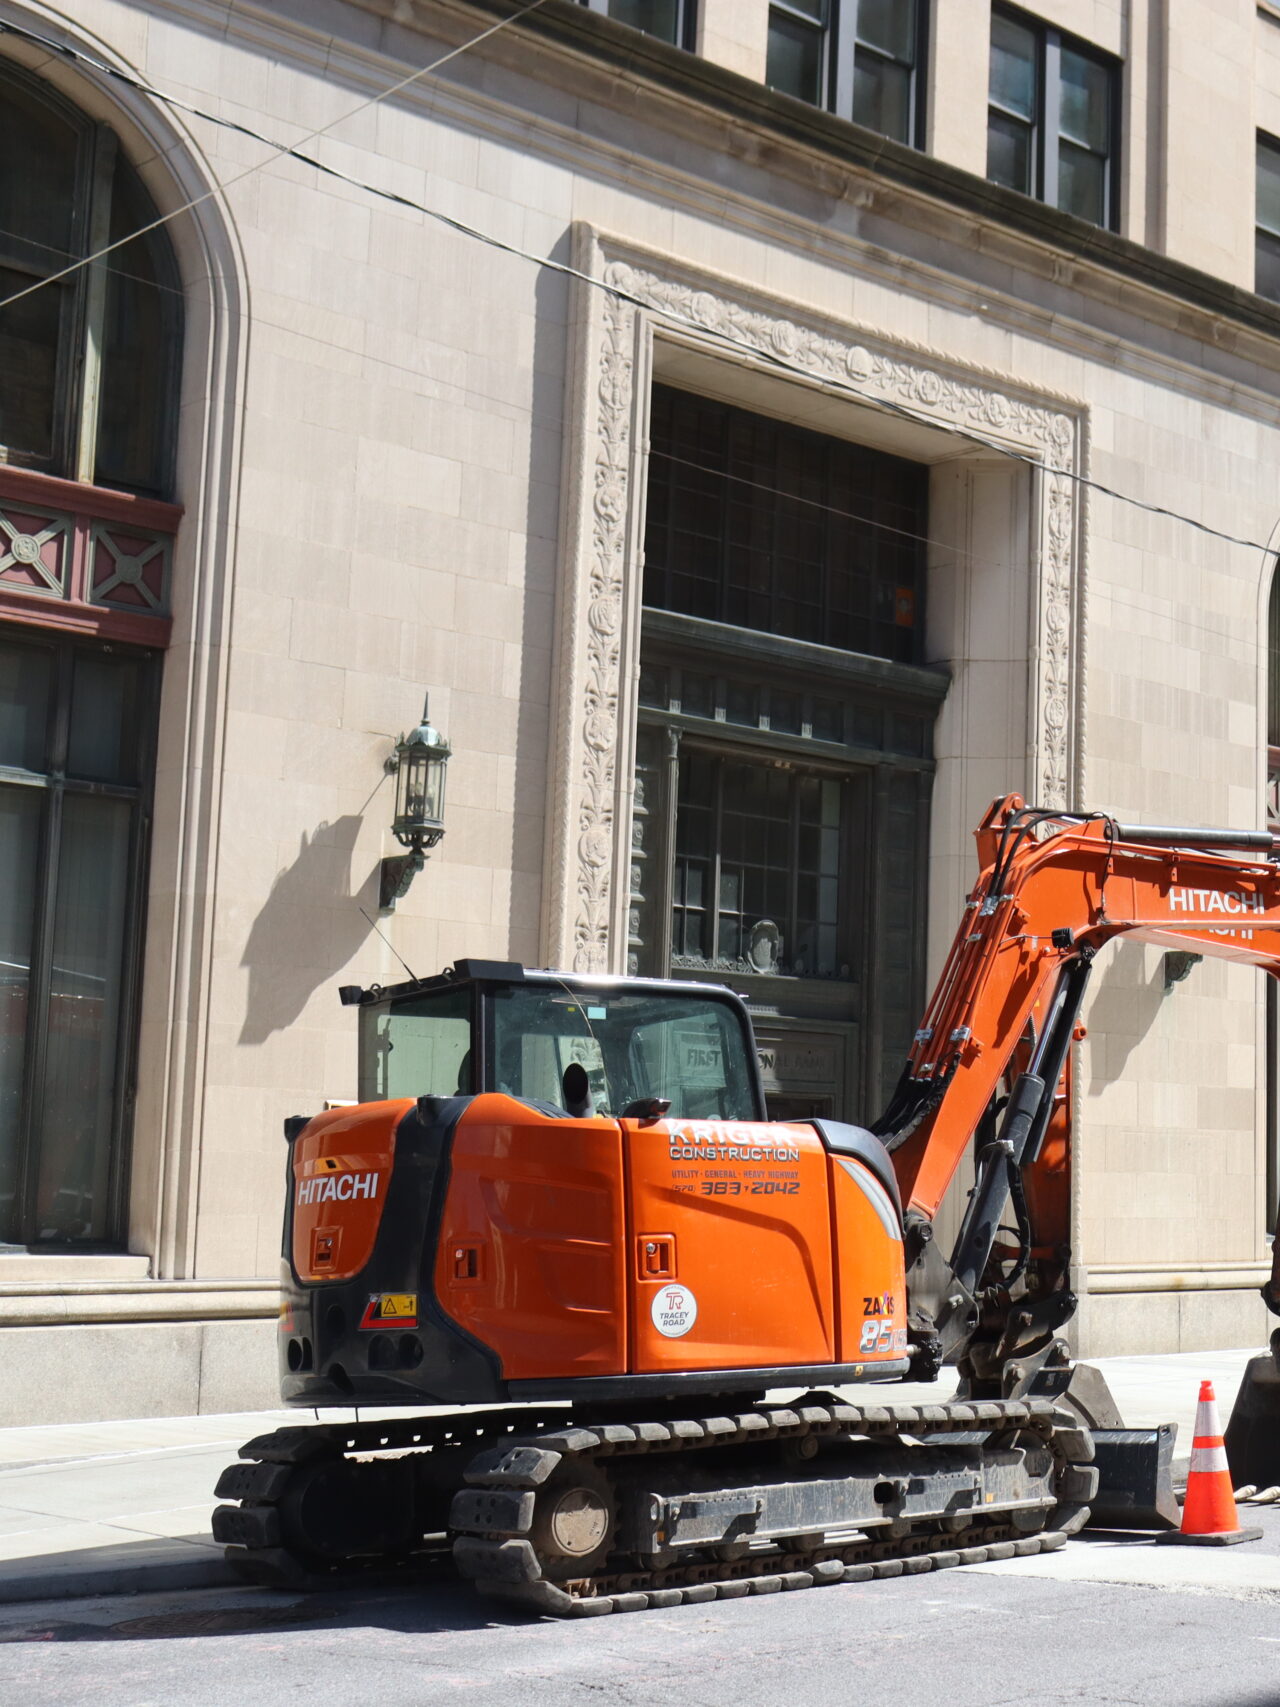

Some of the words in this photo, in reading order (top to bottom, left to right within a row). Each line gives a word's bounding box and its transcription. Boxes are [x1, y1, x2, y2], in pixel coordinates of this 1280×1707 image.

[1169, 887, 1265, 915] HITACHI
[687, 1049, 720, 1066] FIRST
[669, 1118, 797, 1146] KRIGER
[669, 1147, 800, 1162] CONSTRUCTION
[671, 1169, 699, 1179] UTILITY
[704, 1170, 737, 1179] GENERAL
[743, 1171, 765, 1179] HEAVY
[768, 1171, 799, 1179] HIGHWAY
[297, 1172, 379, 1206] HITACHI
[659, 1311, 689, 1320] TRACEY
[662, 1318, 686, 1327] ROAD
